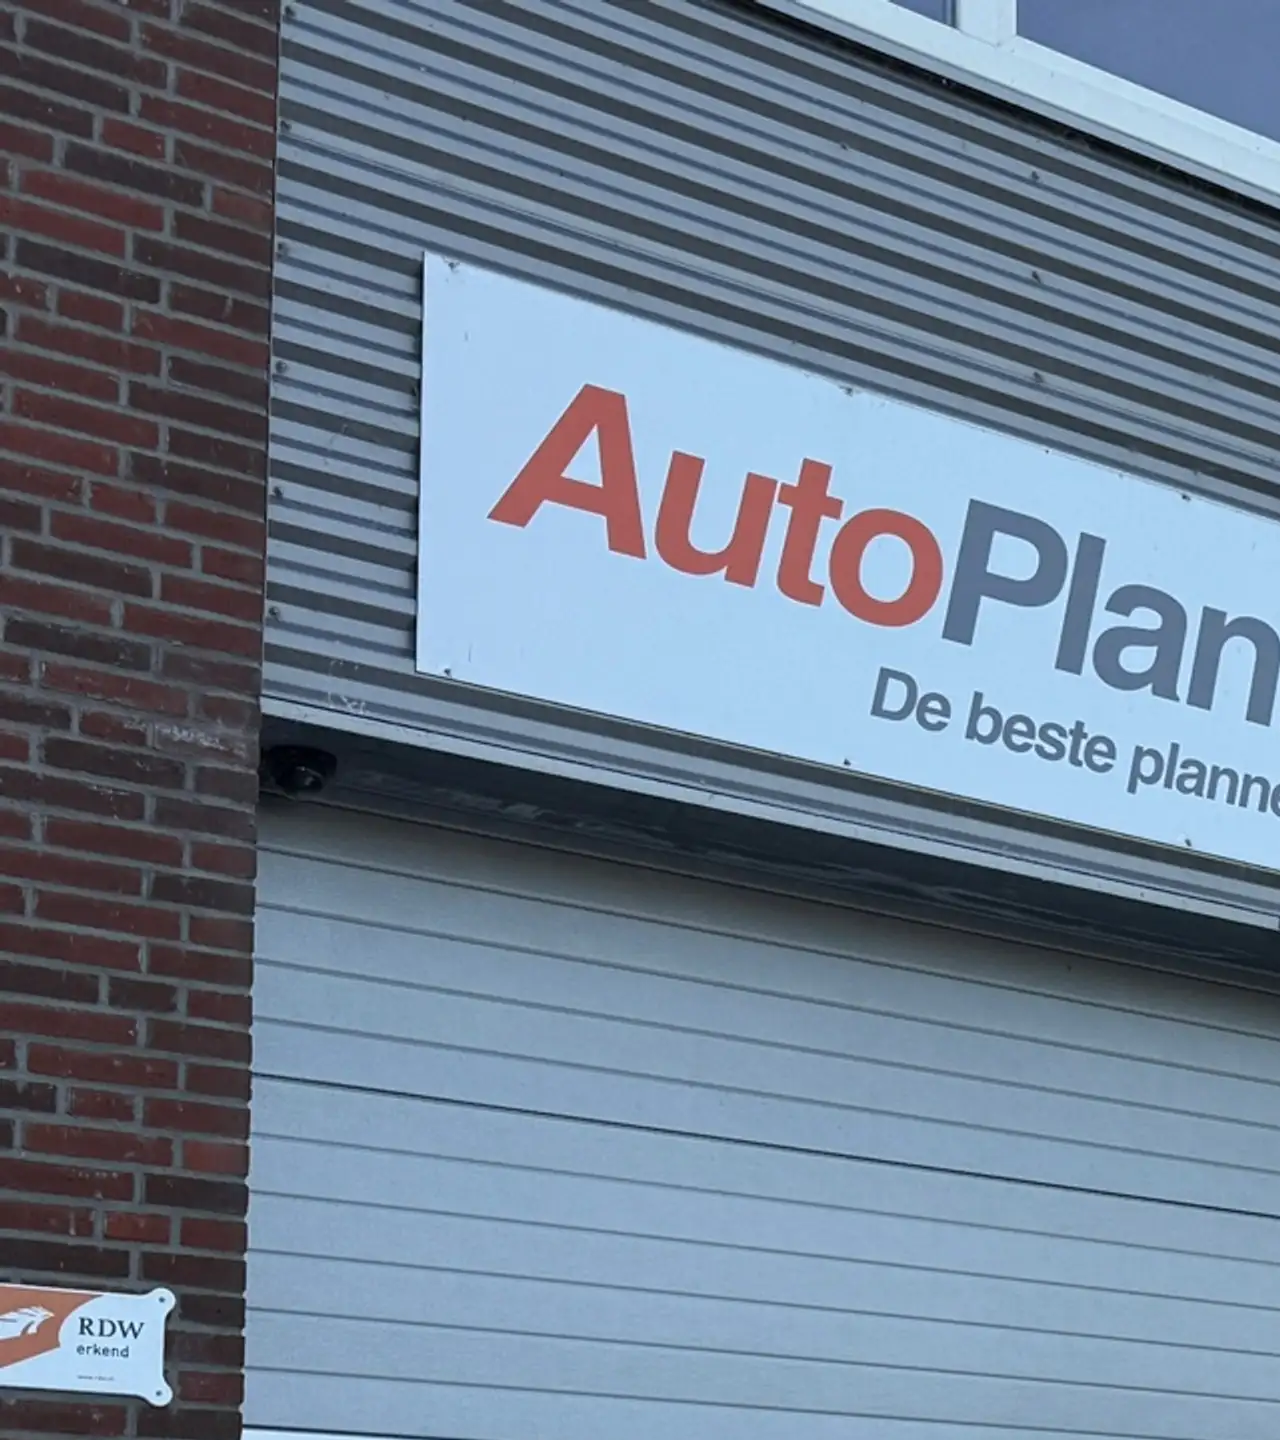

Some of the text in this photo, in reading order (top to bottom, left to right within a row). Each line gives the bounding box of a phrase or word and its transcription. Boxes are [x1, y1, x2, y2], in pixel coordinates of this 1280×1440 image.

[870, 666, 952, 732] De
[964, 691, 1116, 774] beste
[79, 1317, 145, 1338] RDW
[76, 1344, 130, 1358] erkend
